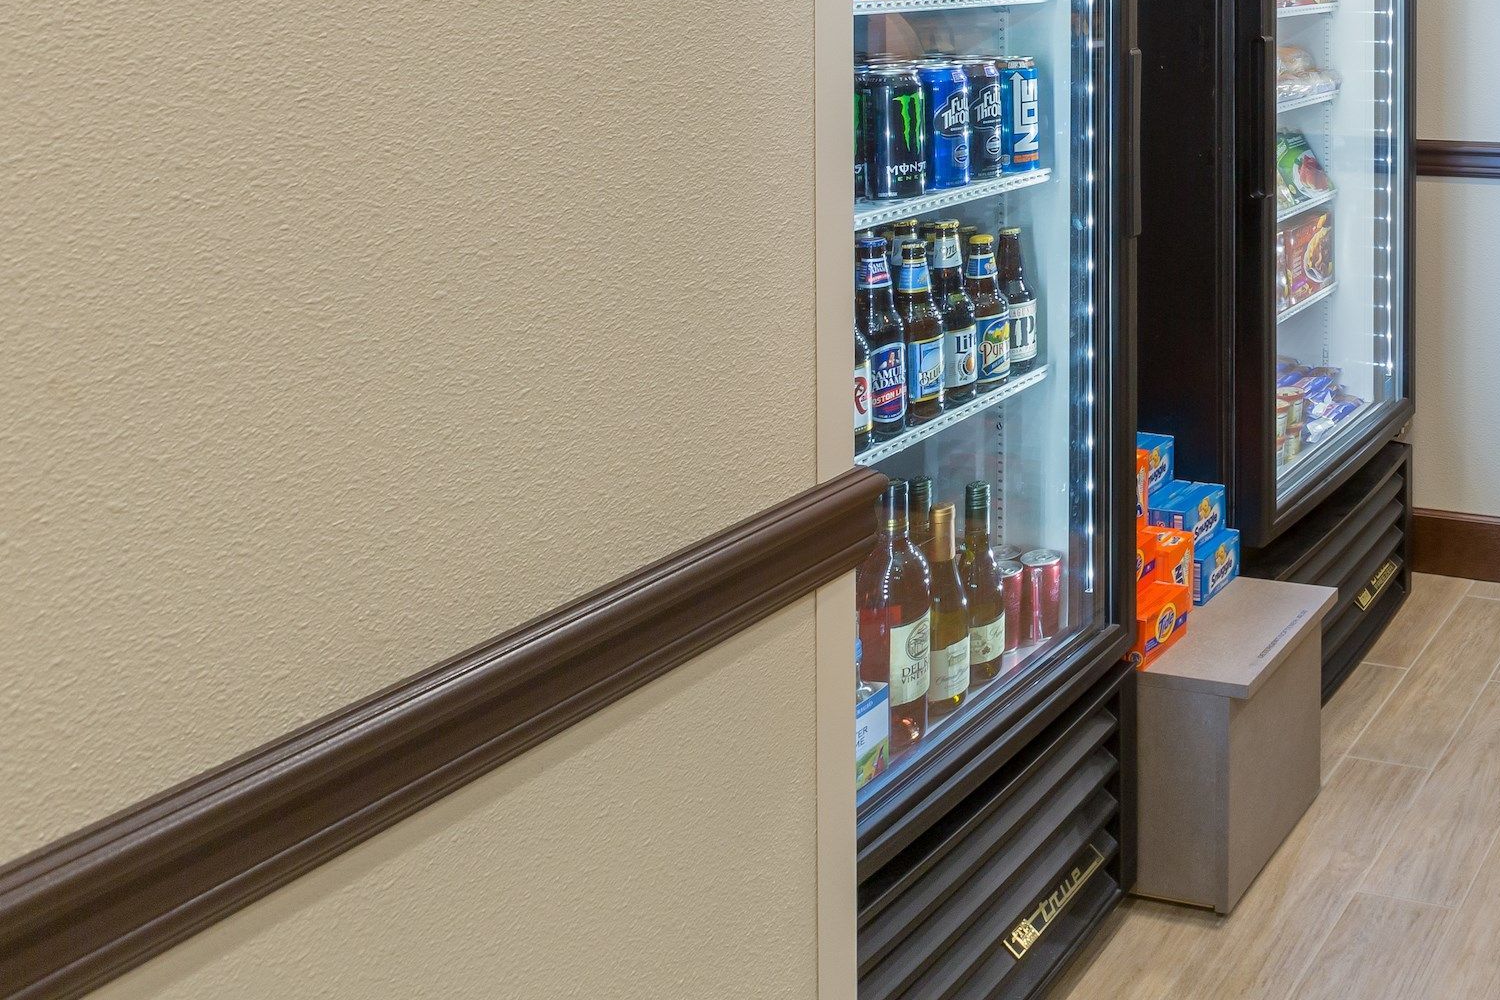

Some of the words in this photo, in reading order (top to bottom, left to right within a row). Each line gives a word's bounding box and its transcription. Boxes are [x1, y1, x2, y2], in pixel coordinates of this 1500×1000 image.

[1009, 71, 1039, 153] NOS
[886, 161, 927, 176] MONST
[1194, 511, 1218, 541] Snuggle
[1210, 556, 1233, 589] Snuggle
